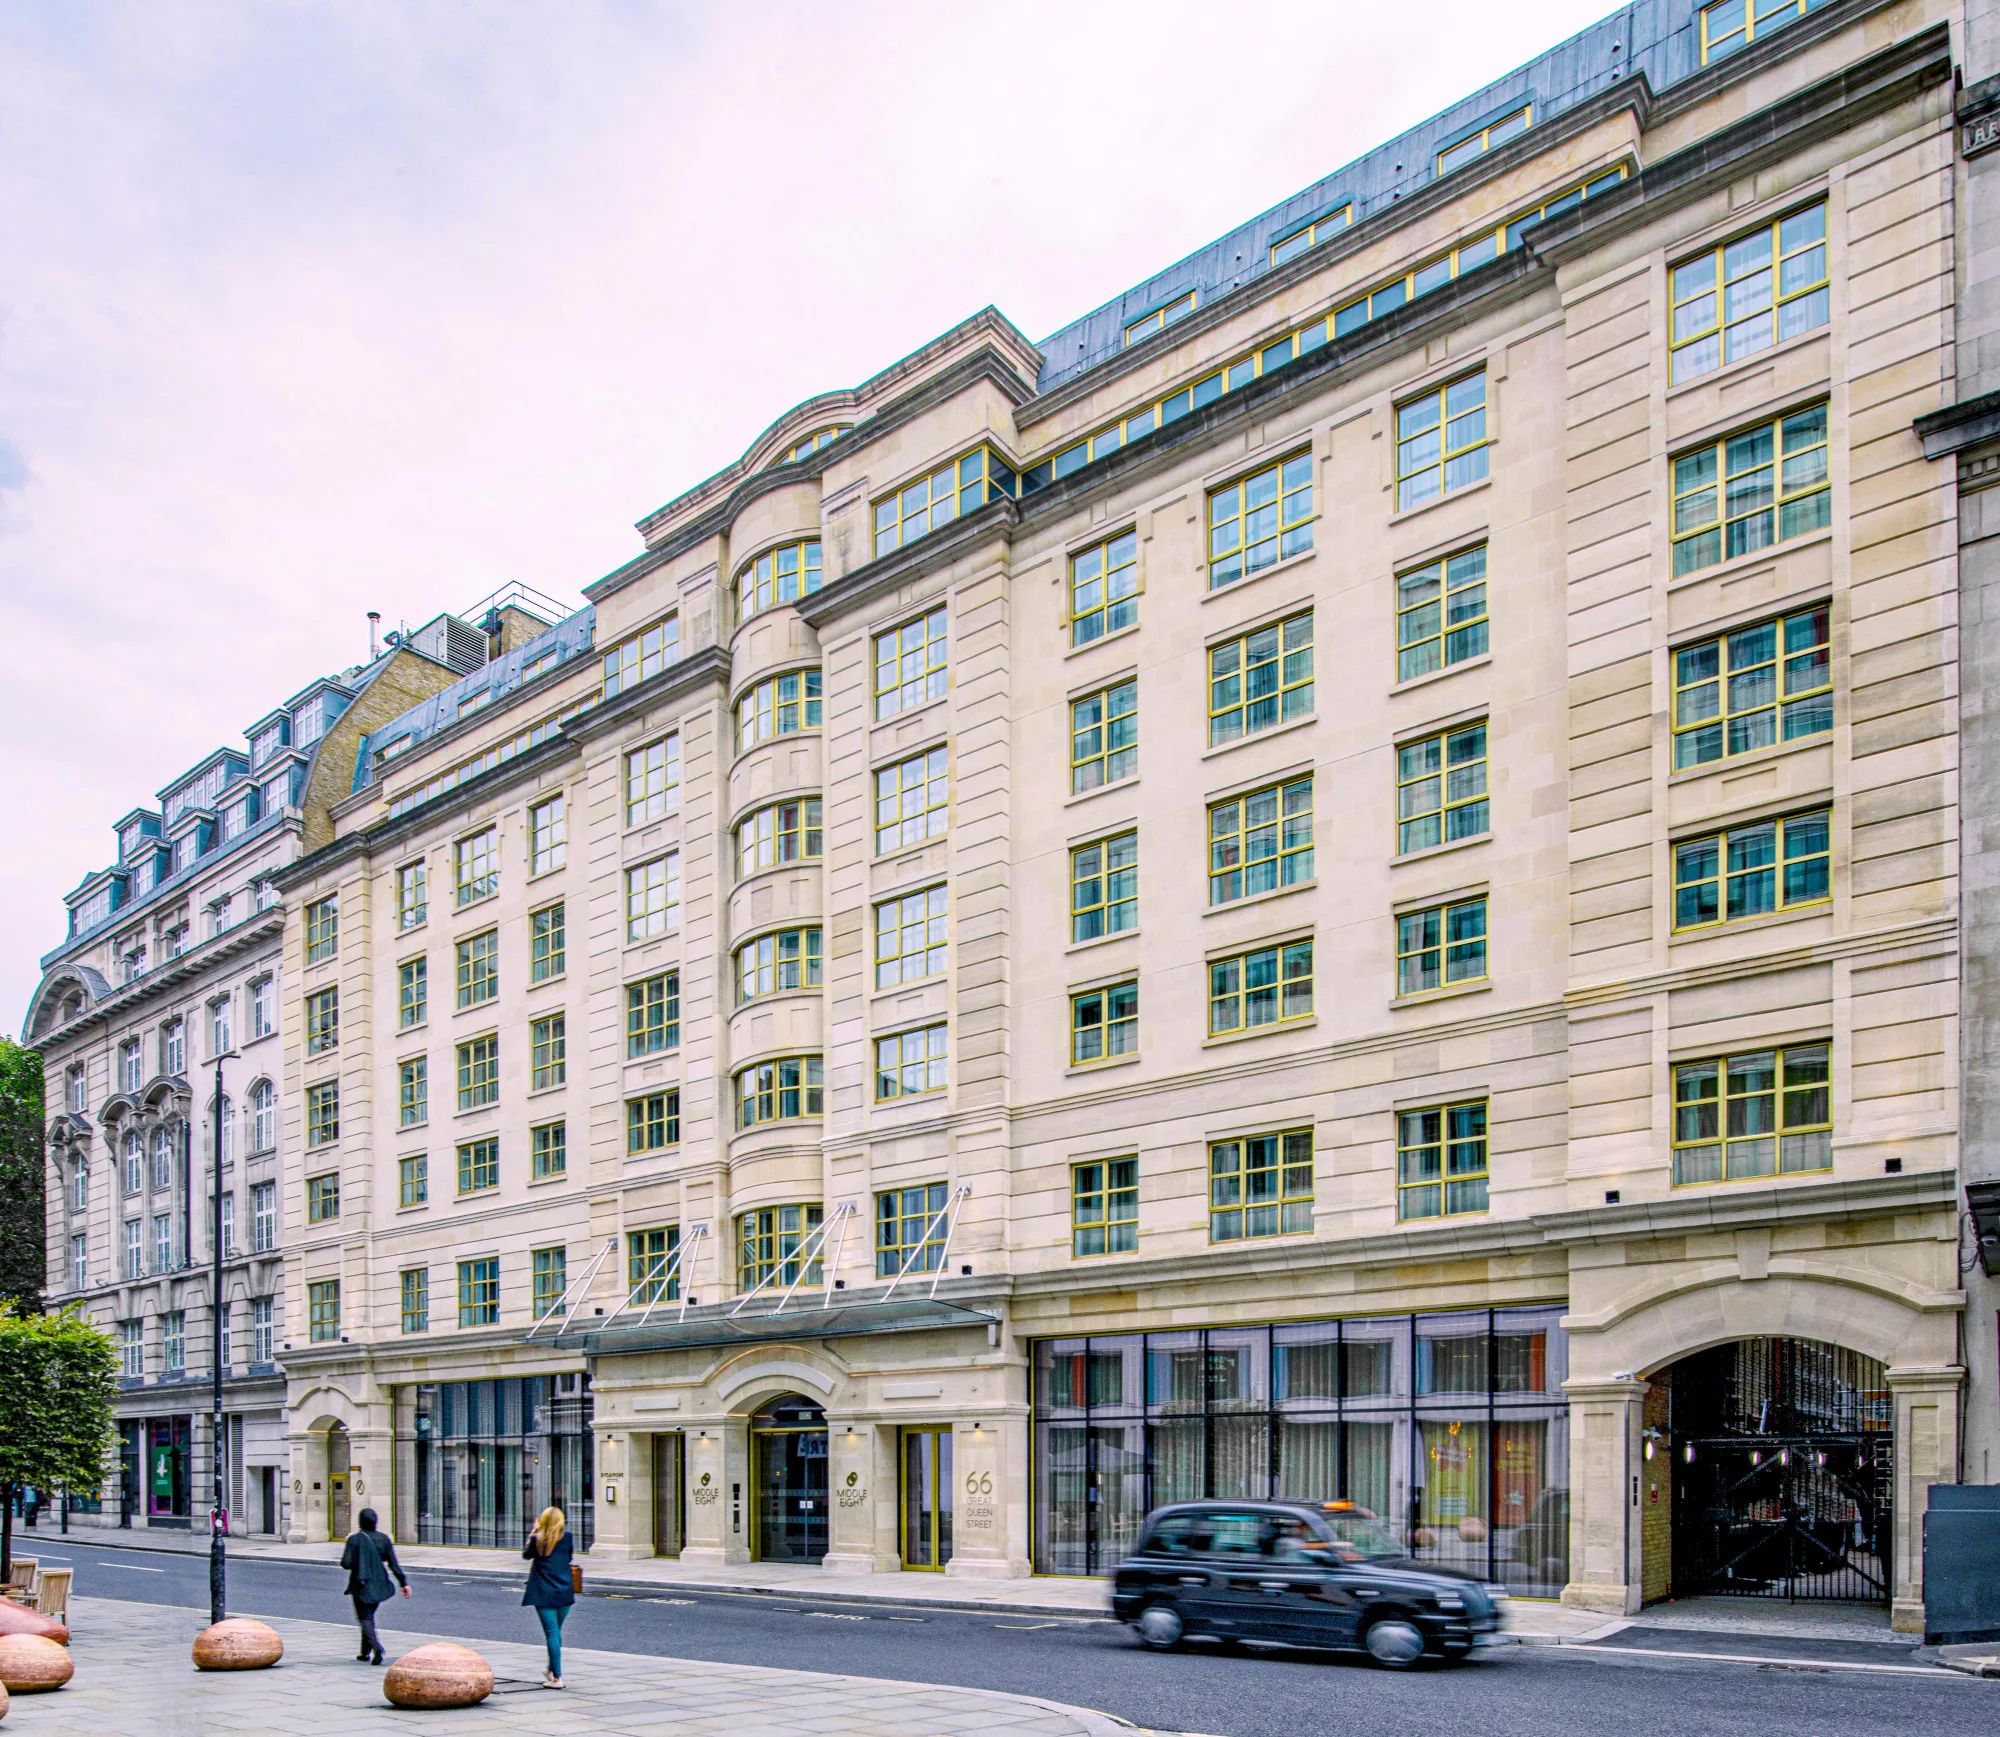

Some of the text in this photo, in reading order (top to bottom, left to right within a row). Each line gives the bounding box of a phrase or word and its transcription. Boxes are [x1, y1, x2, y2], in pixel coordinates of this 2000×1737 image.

[966, 1470, 993, 1495] 66
[692, 1488, 719, 1497] MIDDLE
[836, 1489, 868, 1498] MIDDLE
[695, 1496, 716, 1505] EIGHT
[839, 1497, 864, 1507] EIGHT
[967, 1496, 993, 1505] GREAT
[966, 1508, 993, 1517] QUEEN
[966, 1519, 993, 1529] STREET
